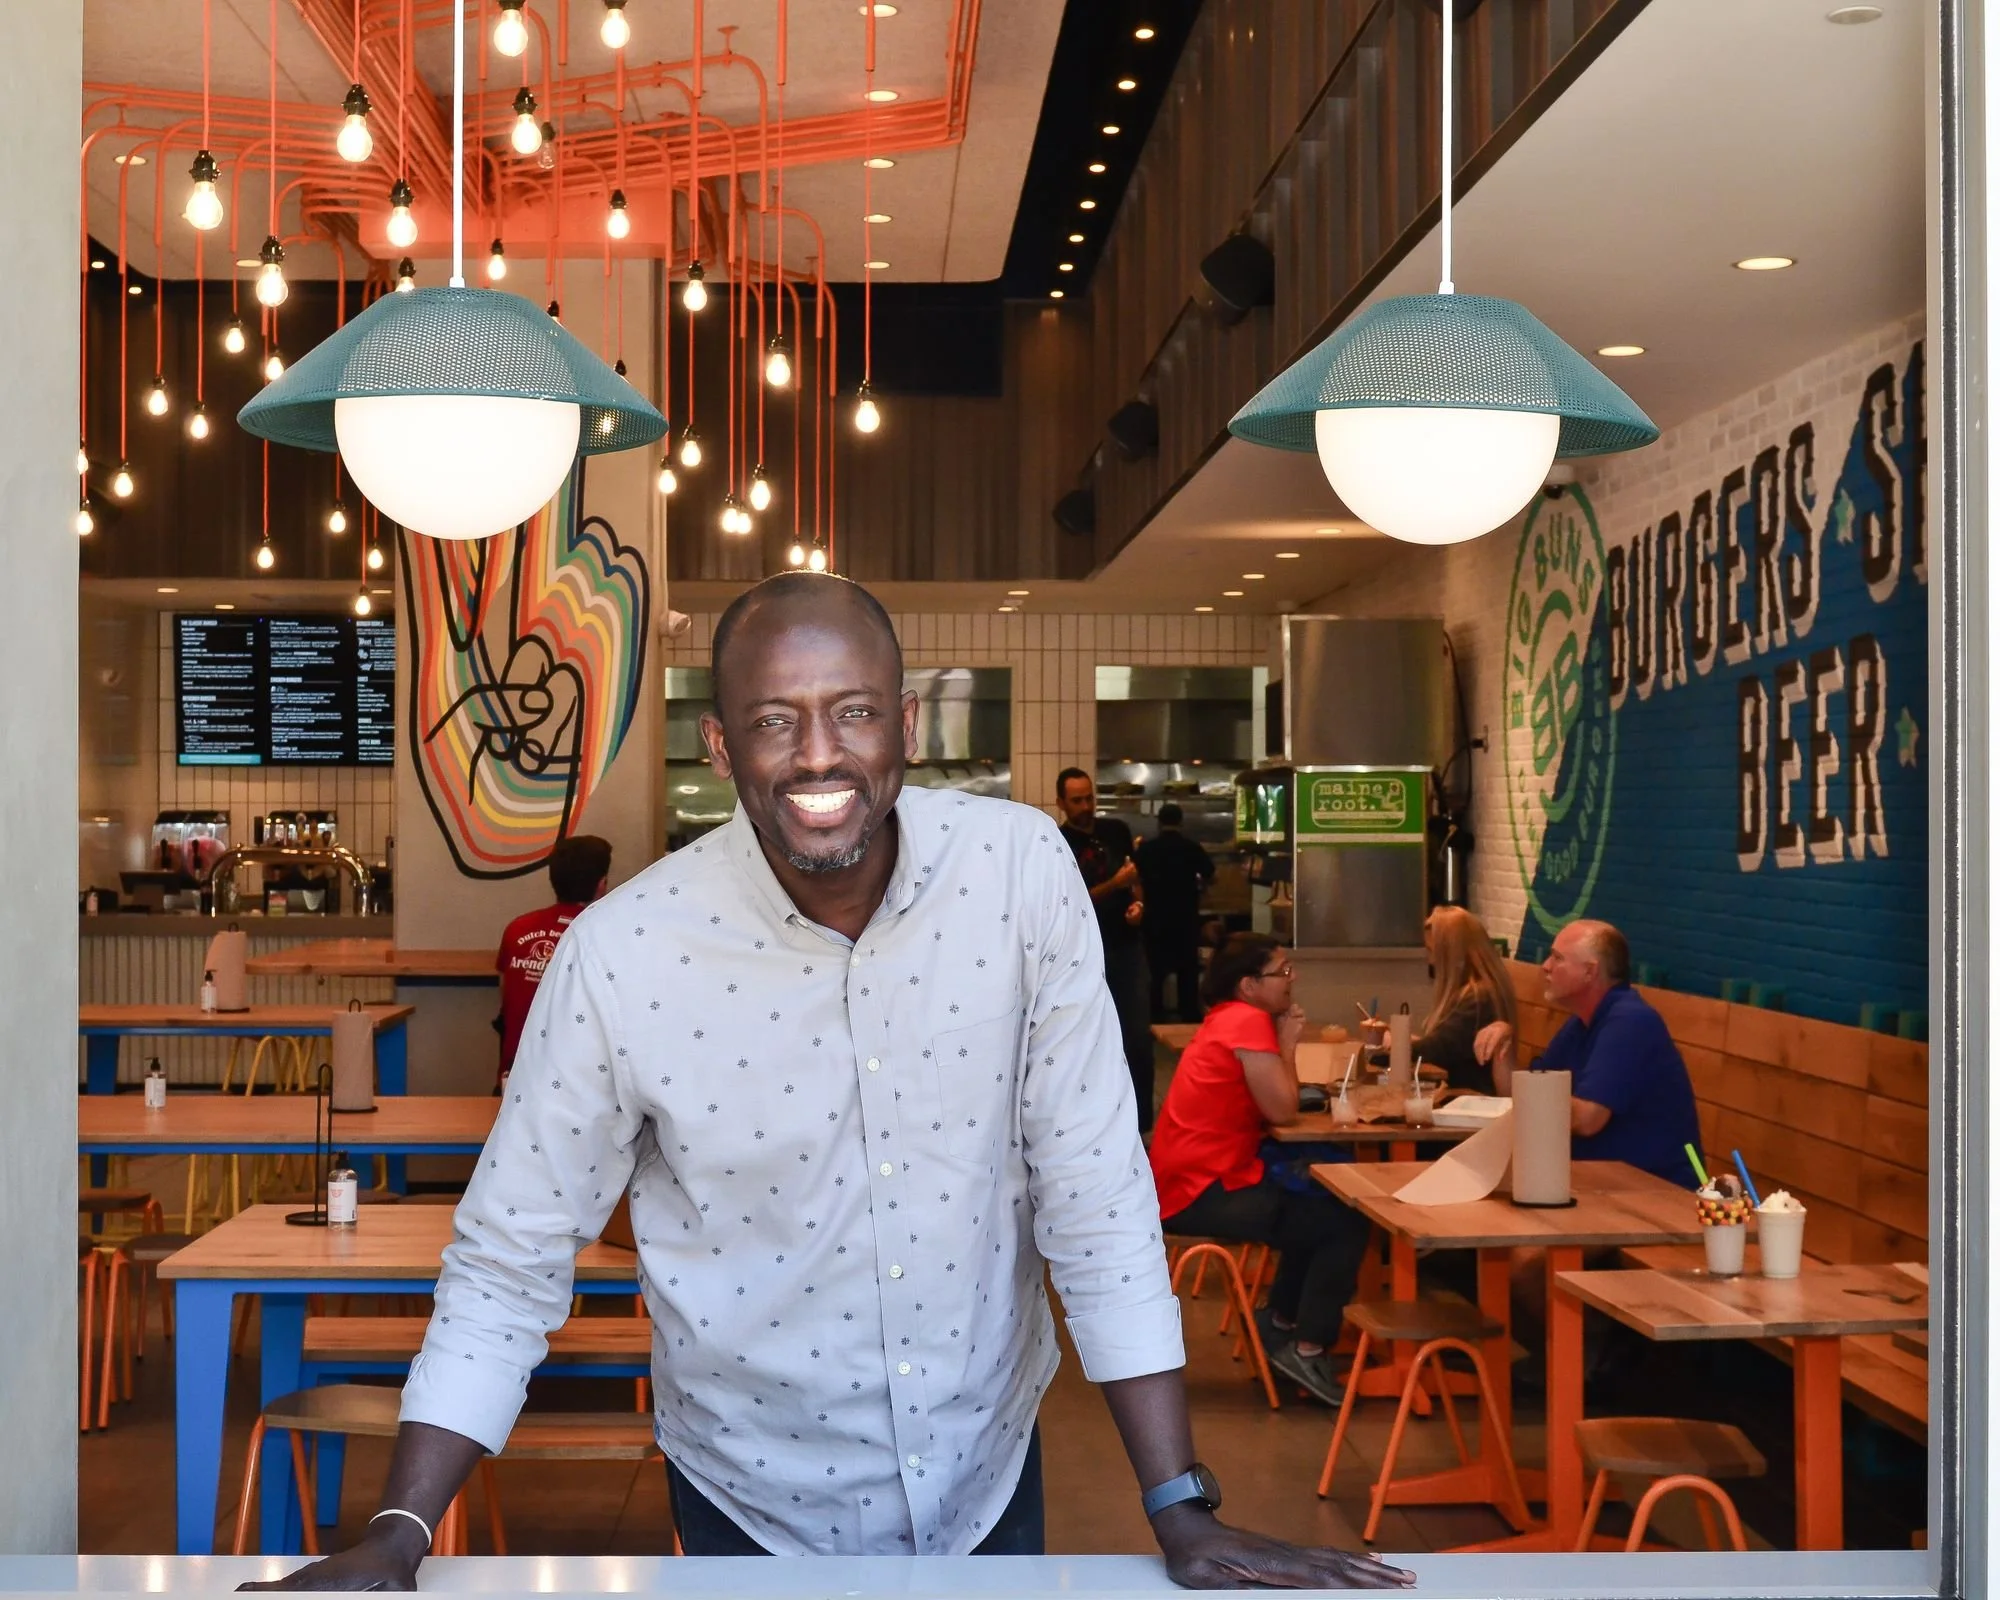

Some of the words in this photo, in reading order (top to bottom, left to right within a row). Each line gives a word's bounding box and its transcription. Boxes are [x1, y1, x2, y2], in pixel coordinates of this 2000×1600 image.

[1608, 421, 1820, 710] BURGERS
[1511, 590, 1533, 728] BIG
[1534, 511, 1595, 616] BUNS
[1736, 632, 1888, 872] BEER
[1319, 781, 1383, 796] maine
[1318, 797, 1376, 811] root.
[517, 930, 546, 945] Dutch
[511, 956, 549, 970] Arend
